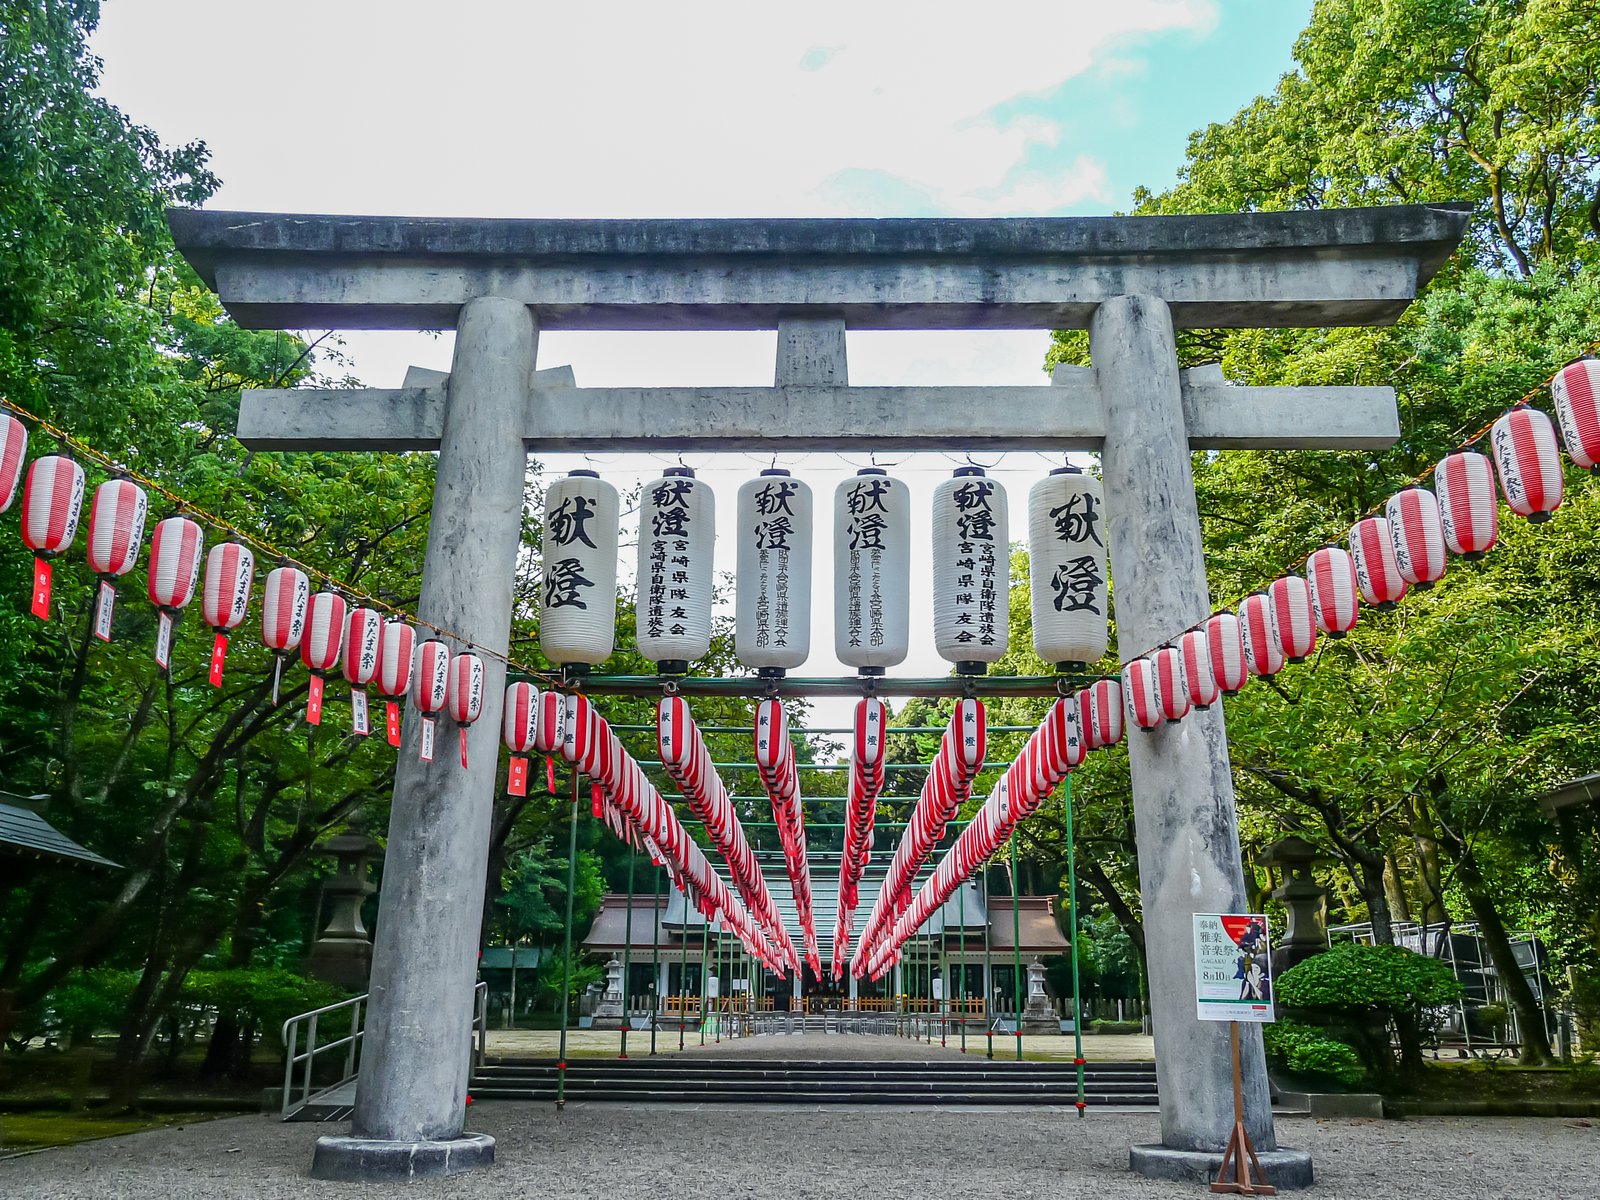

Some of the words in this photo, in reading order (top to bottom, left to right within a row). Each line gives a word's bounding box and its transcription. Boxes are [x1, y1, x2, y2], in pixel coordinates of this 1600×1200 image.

[1553, 382, 1577, 452] みたま祭
[1496, 429, 1521, 500] みたま祭
[67, 475, 83, 539] みたま祭
[129, 498, 146, 562] みたま祭
[1389, 505, 1408, 570] みたま祭
[234, 557, 251, 615] みたま祭
[648, 539, 668, 638] 宮崎県自衛隊遺族会
[669, 539, 690, 636] 宮崎県隊友会
[1350, 529, 1367, 590] みたま祭
[292, 581, 307, 637] みたま祭
[954, 542, 976, 643] 宮崎県隊友会
[978, 543, 997, 646] 宮崎県自衛隊遺族会
[361, 617, 378, 670] みたま祭
[433, 651, 448, 700] みたま祭
[470, 664, 481, 711] みたま祭
[528, 695, 538, 741] みたま祭
[1200, 932, 1222, 943] 雅楽
[1201, 944, 1233, 956] 音楽祭
